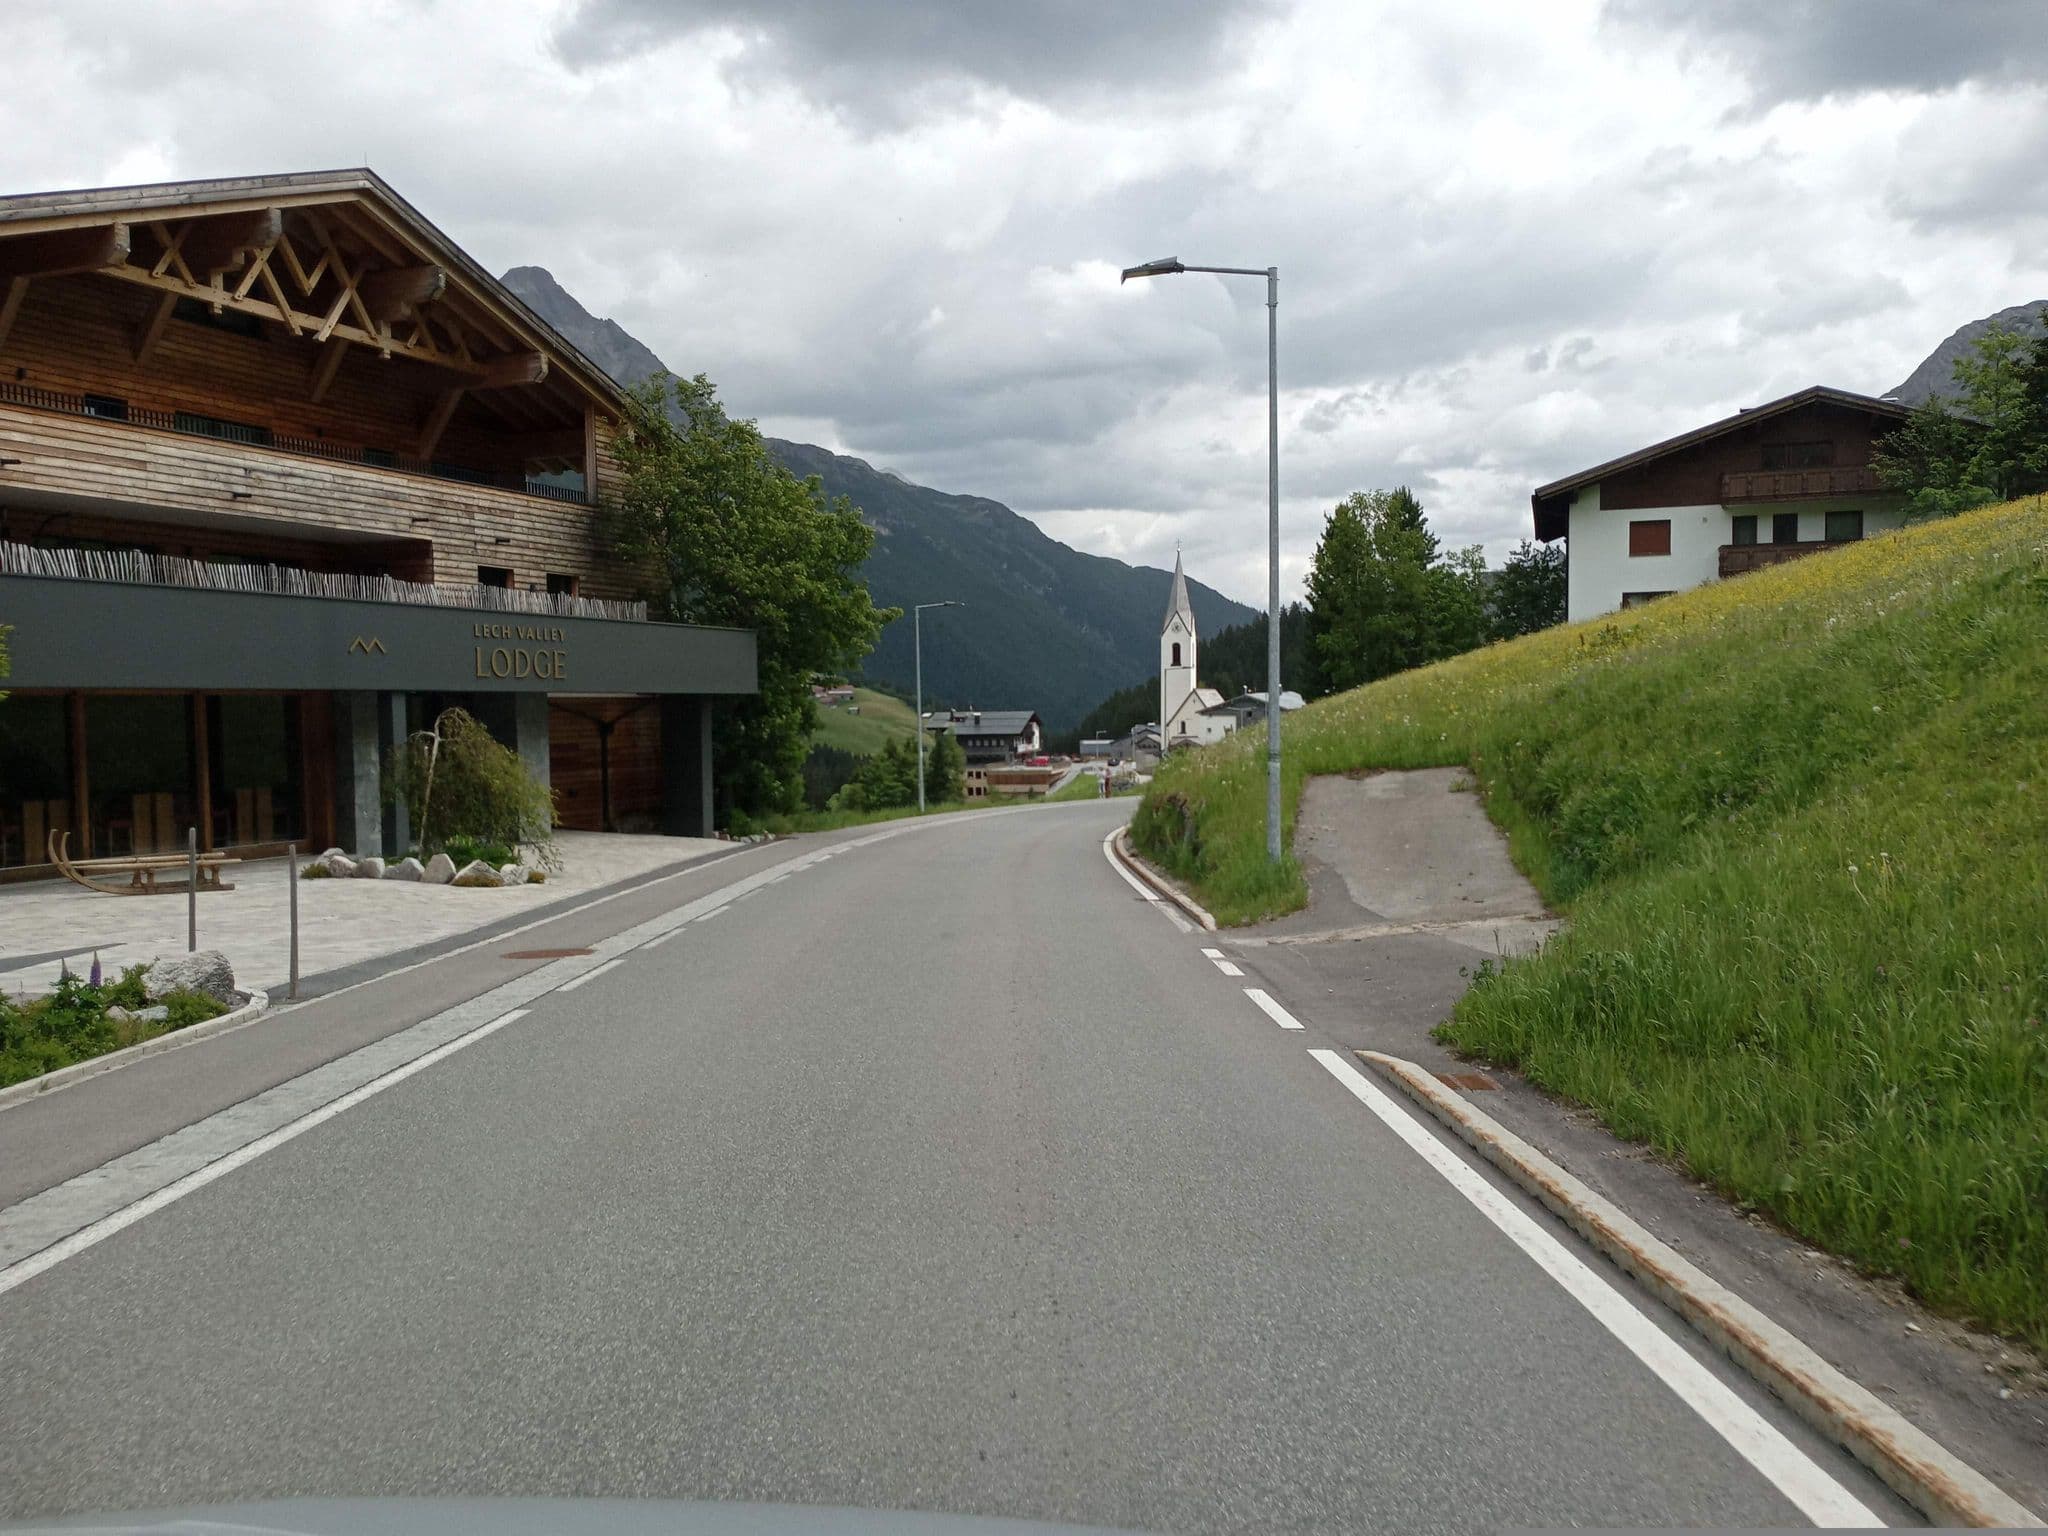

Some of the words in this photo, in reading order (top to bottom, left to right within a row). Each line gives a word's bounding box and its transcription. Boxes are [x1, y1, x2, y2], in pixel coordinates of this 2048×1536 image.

[474, 623, 512, 639] LECH
[517, 625, 566, 642] VALLEY
[475, 646, 567, 680] LODGE
